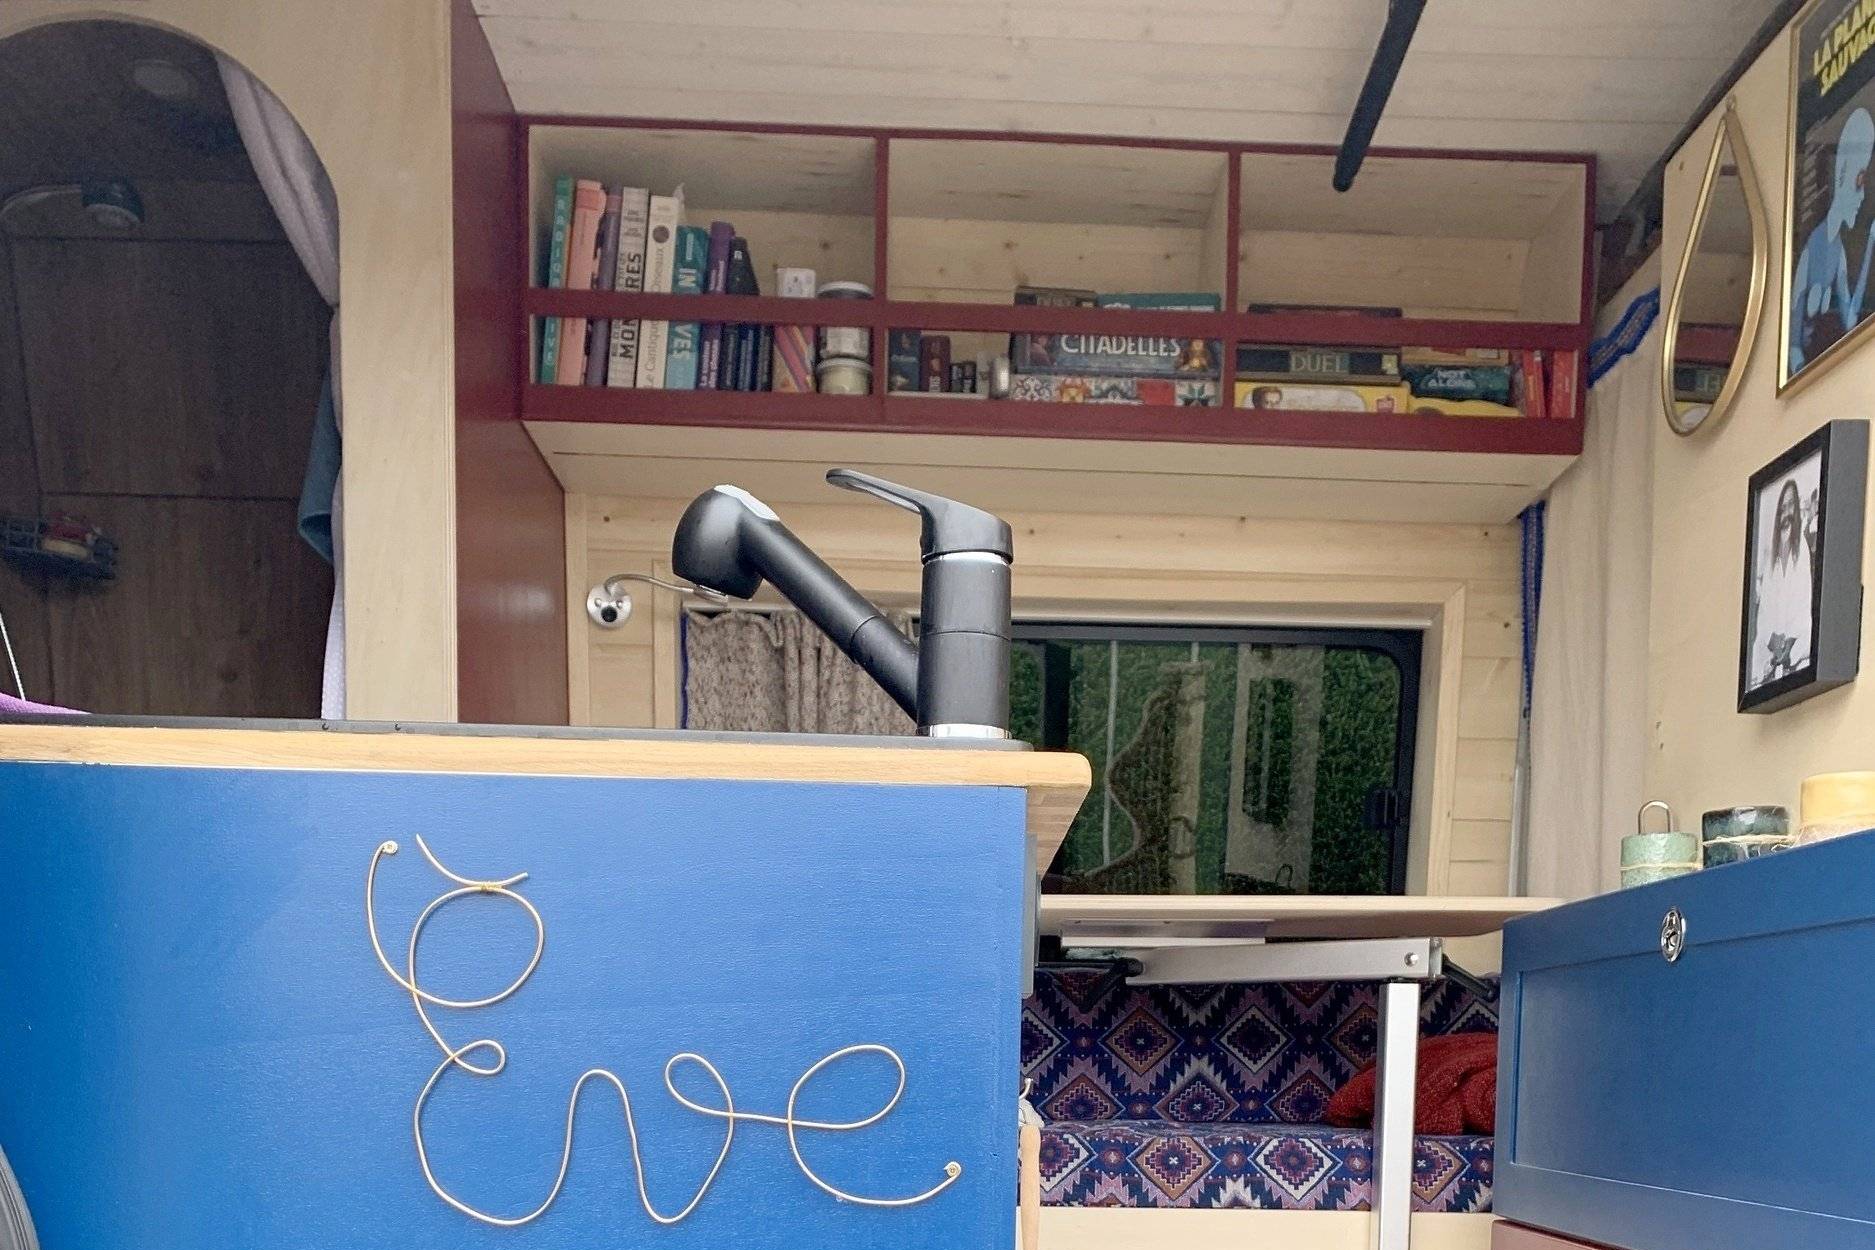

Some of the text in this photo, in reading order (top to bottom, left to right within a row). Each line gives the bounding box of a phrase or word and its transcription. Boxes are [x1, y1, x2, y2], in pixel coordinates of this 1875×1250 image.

[1813, 37, 1832, 76] LA
[1061, 333, 1181, 357] CITADELLES
[1290, 352, 1349, 373] DUEL
